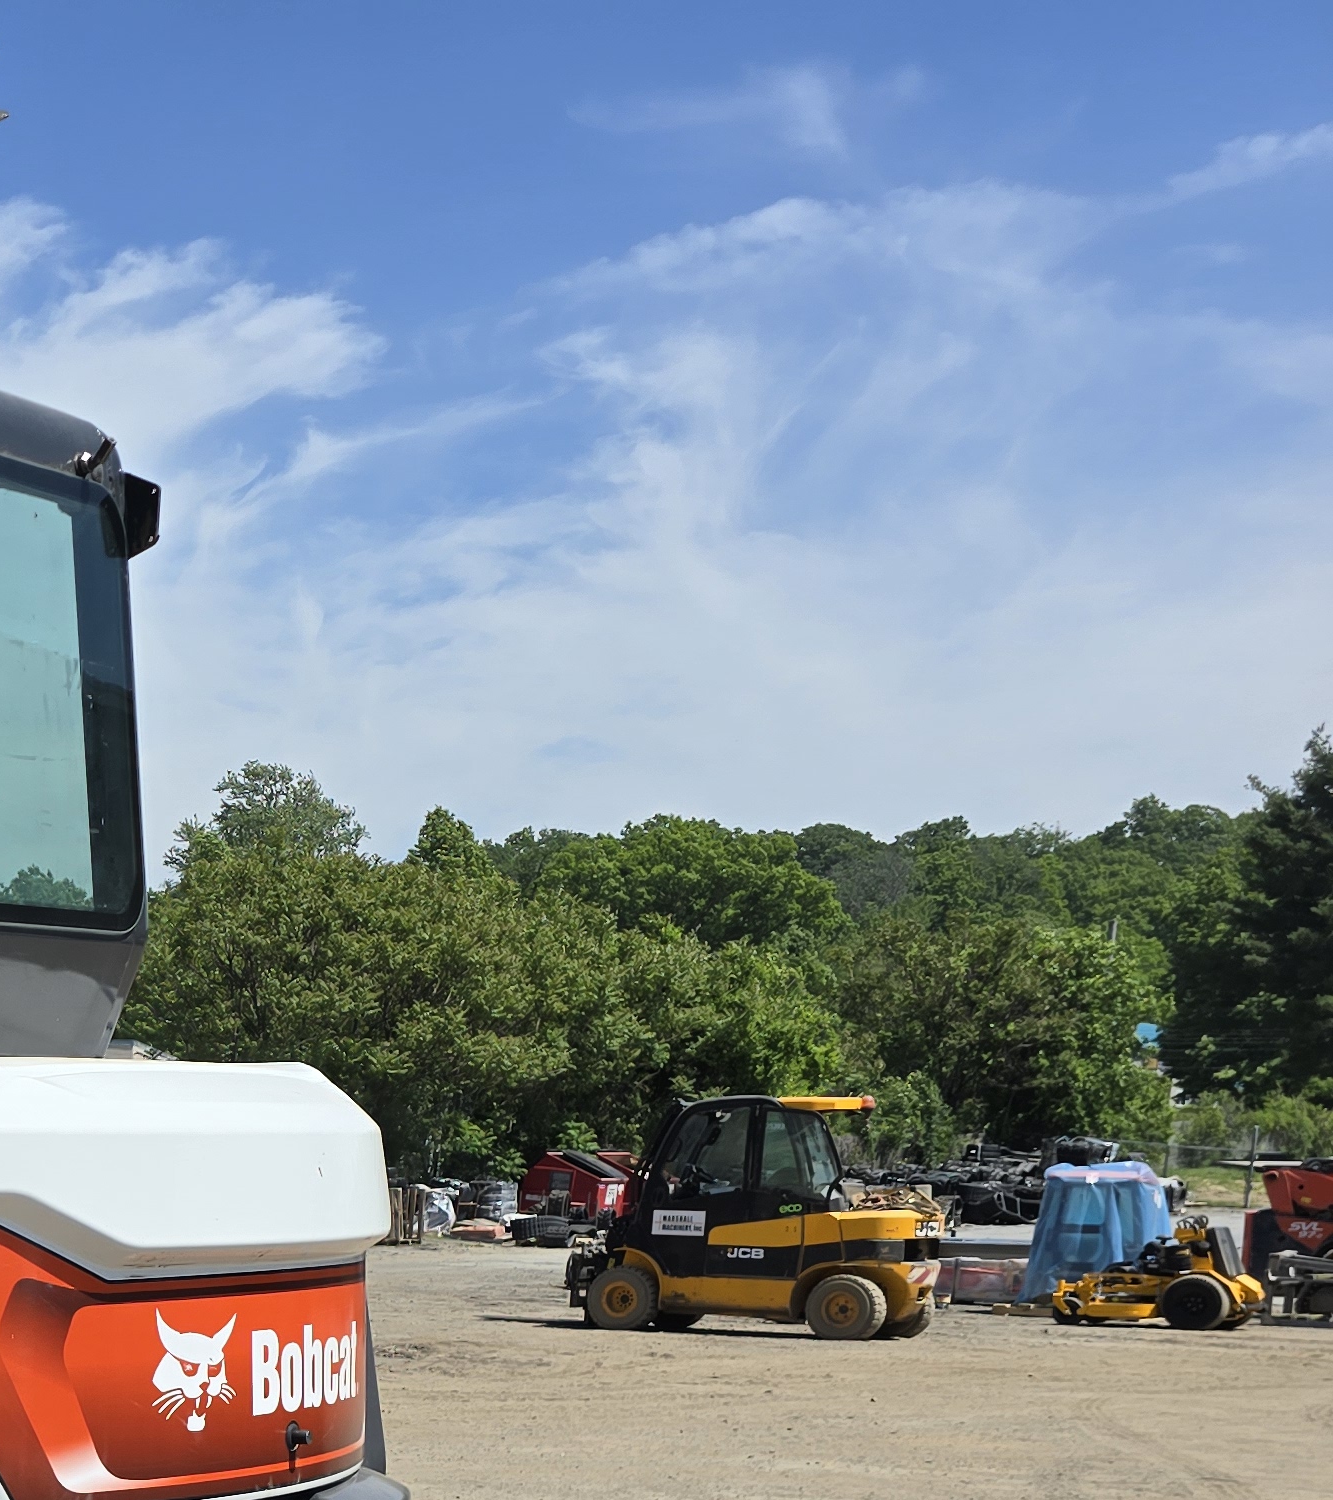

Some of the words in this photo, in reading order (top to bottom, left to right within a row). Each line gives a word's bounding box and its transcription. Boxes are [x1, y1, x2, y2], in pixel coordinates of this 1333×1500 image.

[779, 1204, 802, 1214] eco
[662, 1215, 693, 1223] MARSHALL
[1288, 1221, 1323, 1231] SVL
[727, 1247, 764, 1259] JCB
[252, 1320, 357, 1416] Bobcat
